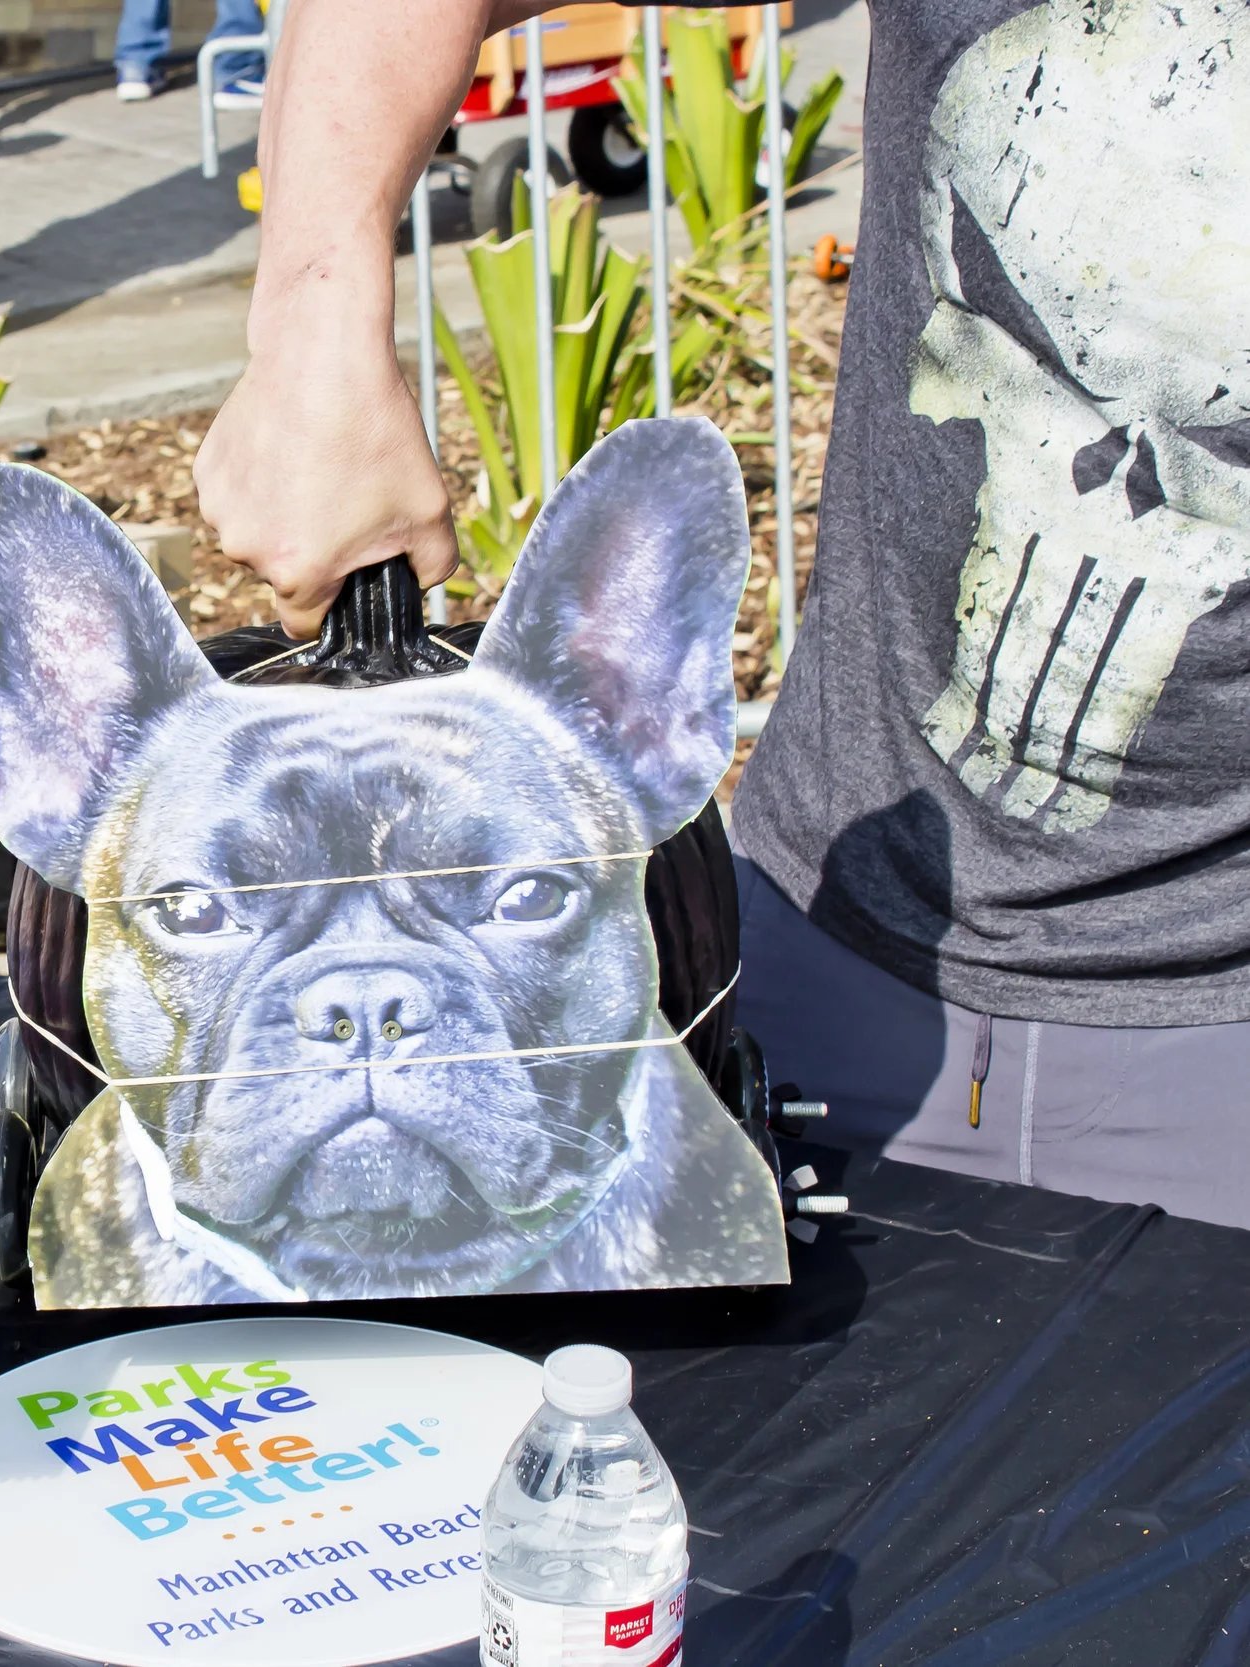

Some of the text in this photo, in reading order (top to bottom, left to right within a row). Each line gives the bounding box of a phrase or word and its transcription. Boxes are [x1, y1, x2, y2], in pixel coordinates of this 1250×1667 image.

[17, 1359, 292, 1430] Parks
[46, 1386, 318, 1474] Make
[119, 1432, 319, 1491] Life
[147, 1551, 483, 1647] Parks and Recre
[157, 1540, 370, 1600] Manhattan
[610, 1615, 650, 1636] MARKET
[615, 1627, 646, 1641] PANTRY
